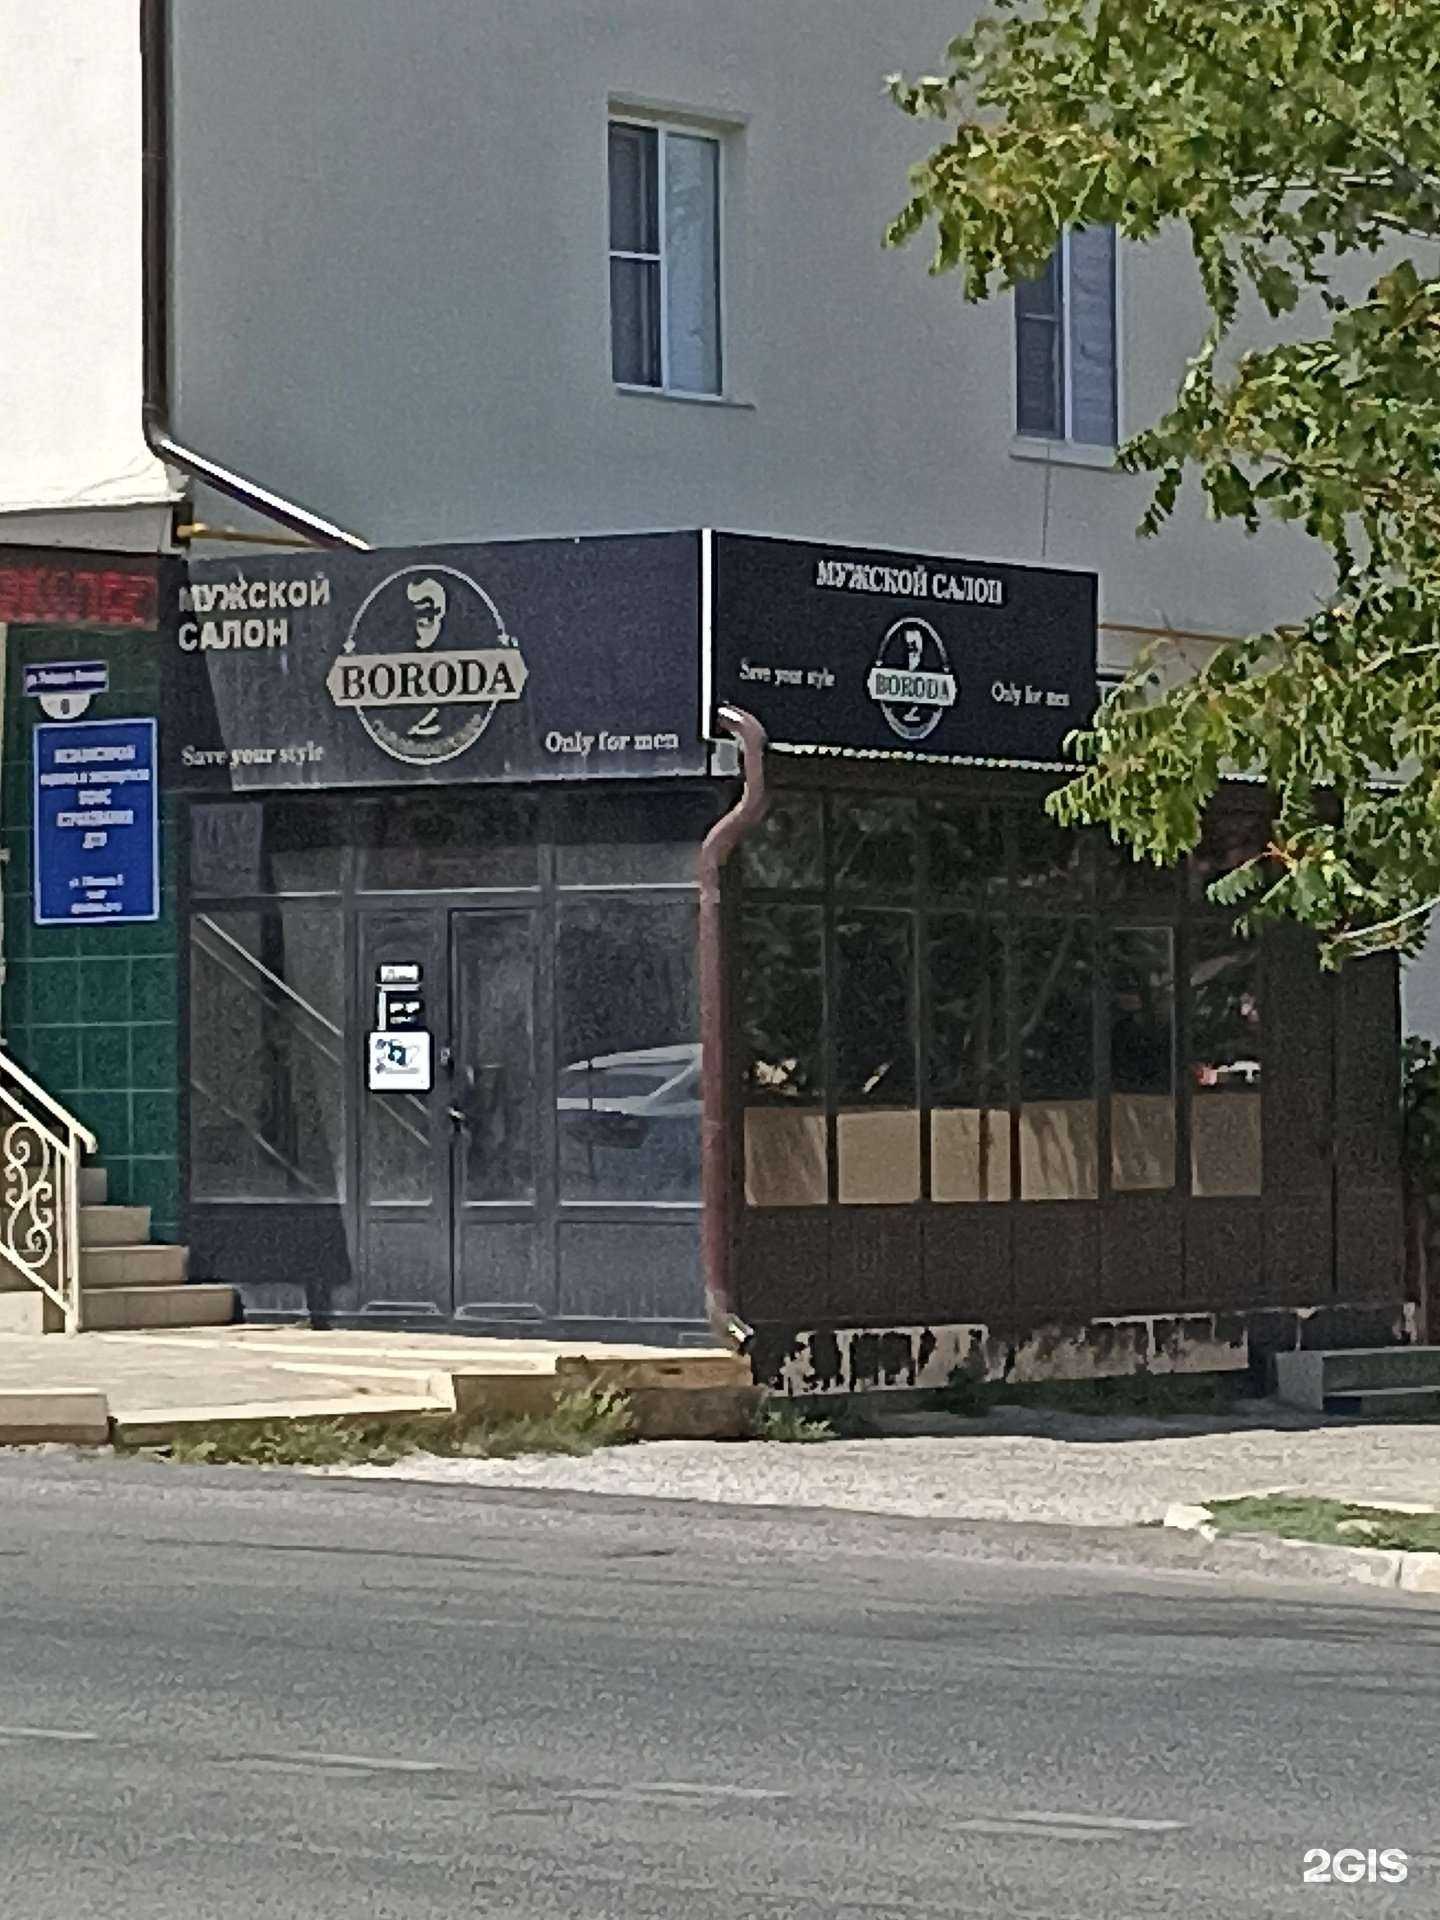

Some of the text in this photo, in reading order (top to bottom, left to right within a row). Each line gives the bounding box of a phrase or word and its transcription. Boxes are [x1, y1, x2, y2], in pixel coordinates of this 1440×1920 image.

[179, 571, 330, 612] МУЖСКОЙ
[815, 560, 1003, 605] МУЖСКОЙ САЛОН
[179, 618, 289, 651] САЛОН
[338, 658, 517, 700] BORODA
[875, 673, 951, 701] BORODA
[181, 740, 324, 768] Save your style
[545, 730, 680, 757] Only for men
